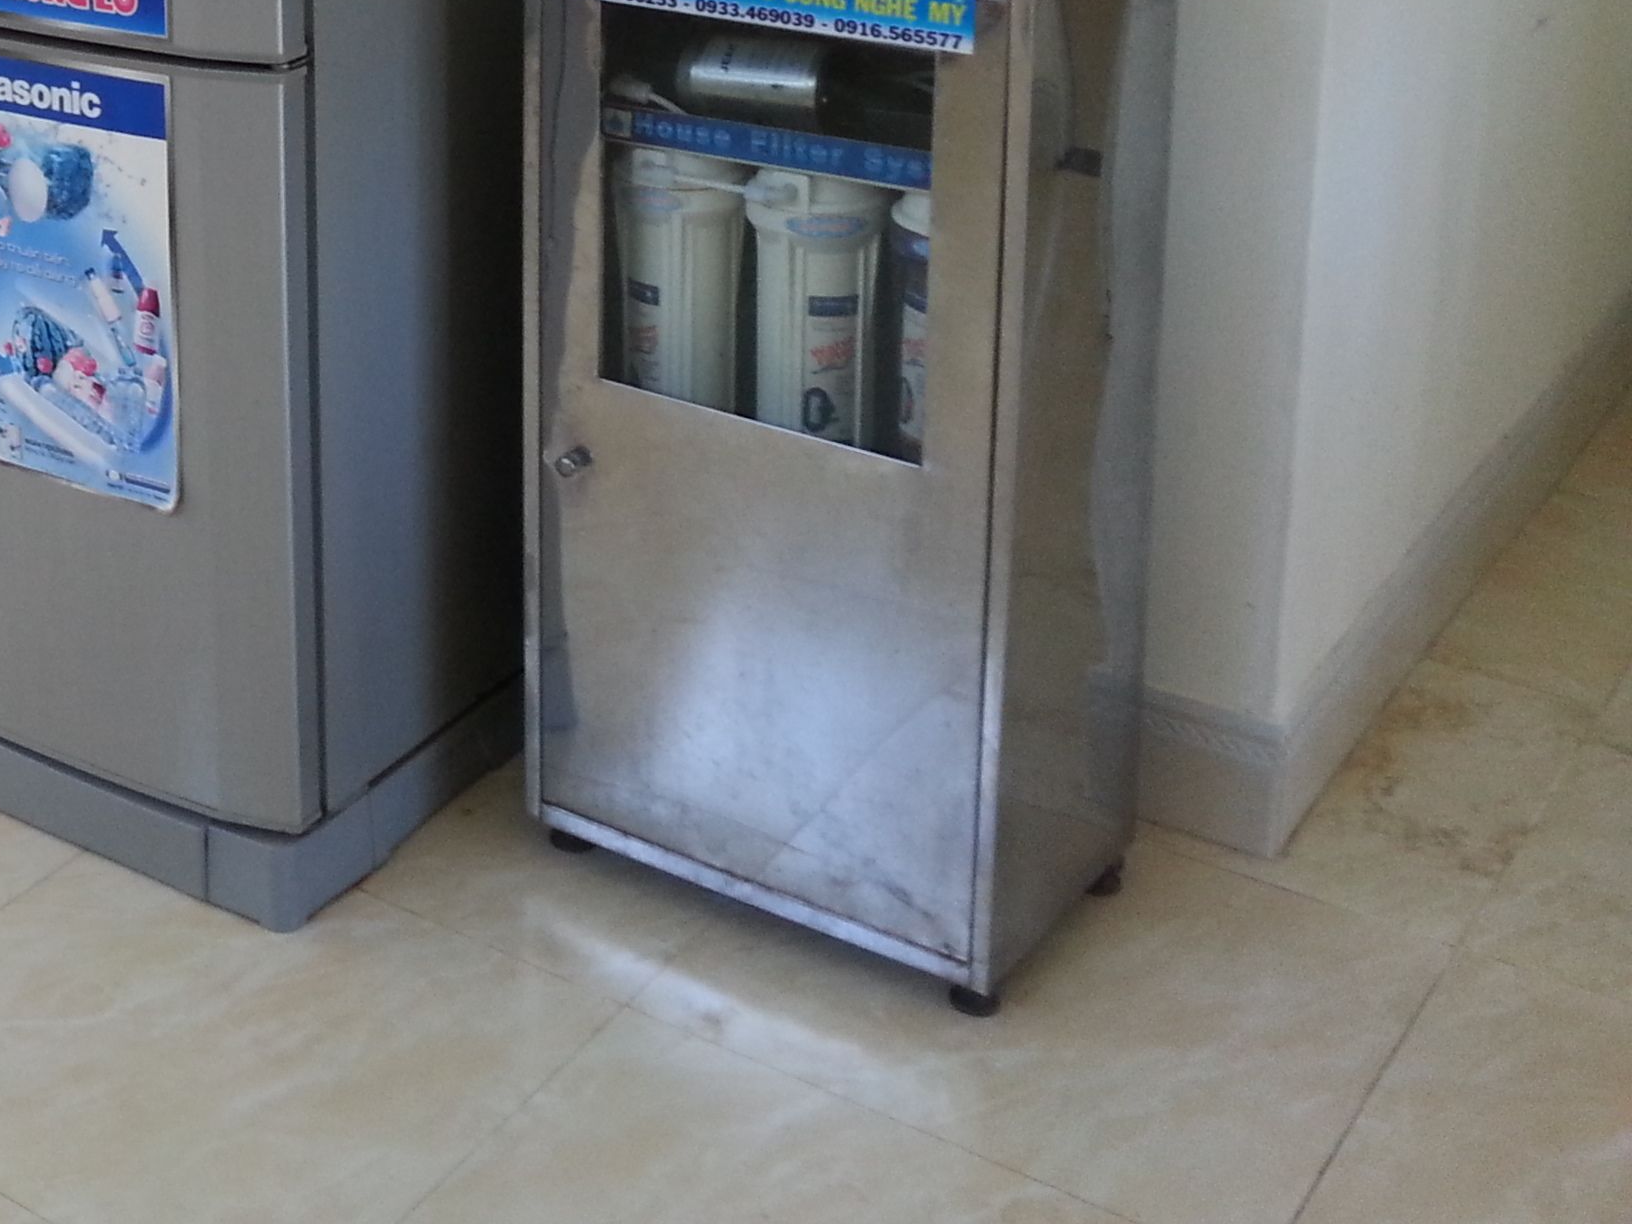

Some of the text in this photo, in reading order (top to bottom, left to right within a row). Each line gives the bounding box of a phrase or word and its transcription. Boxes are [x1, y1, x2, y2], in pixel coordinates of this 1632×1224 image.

[834, 18, 963, 49] 0916.565577
[633, 111, 732, 146] House
[863, 147, 932, 180] Sys
